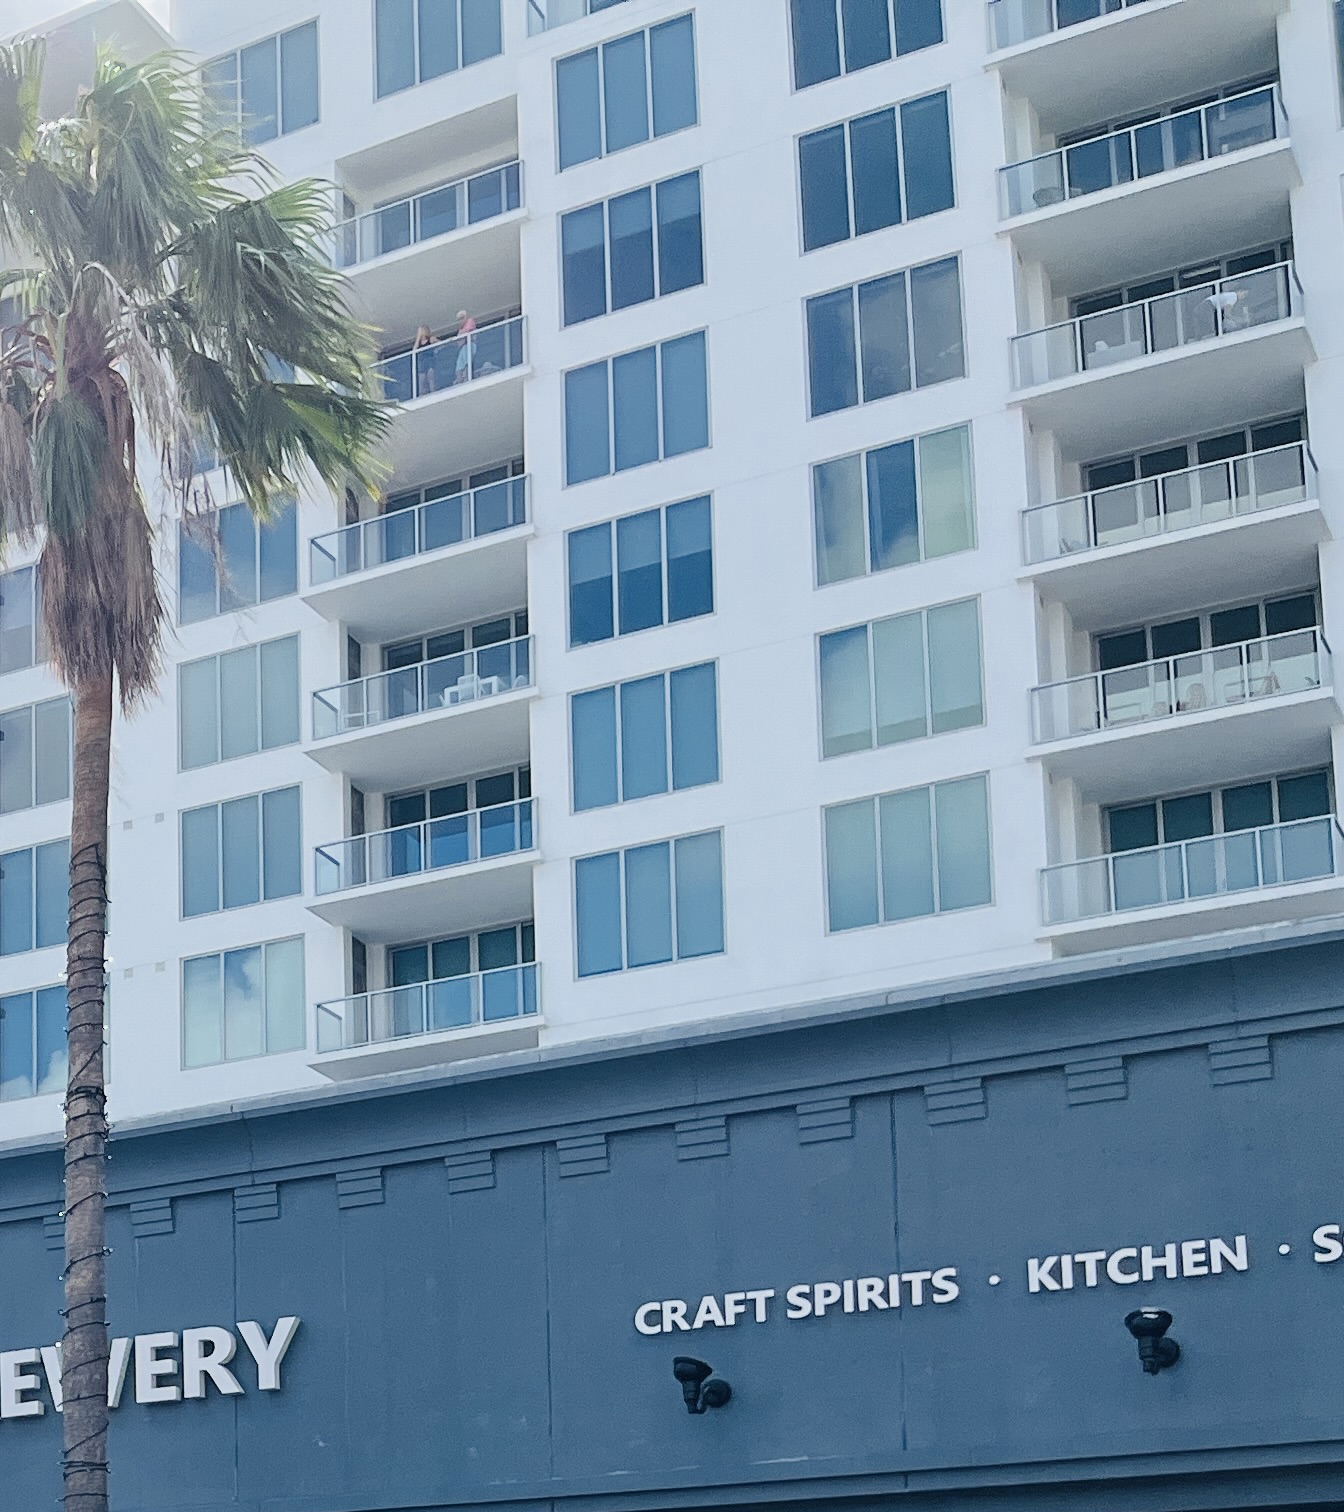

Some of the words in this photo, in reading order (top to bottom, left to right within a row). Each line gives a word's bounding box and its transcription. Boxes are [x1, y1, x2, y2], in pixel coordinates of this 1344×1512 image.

[634, 1288, 775, 1335] CRAFT
[786, 1267, 960, 1320] SPIRITS
[1026, 1235, 1249, 1293] KITCHEN
[1312, 1224, 1344, 1263] S
